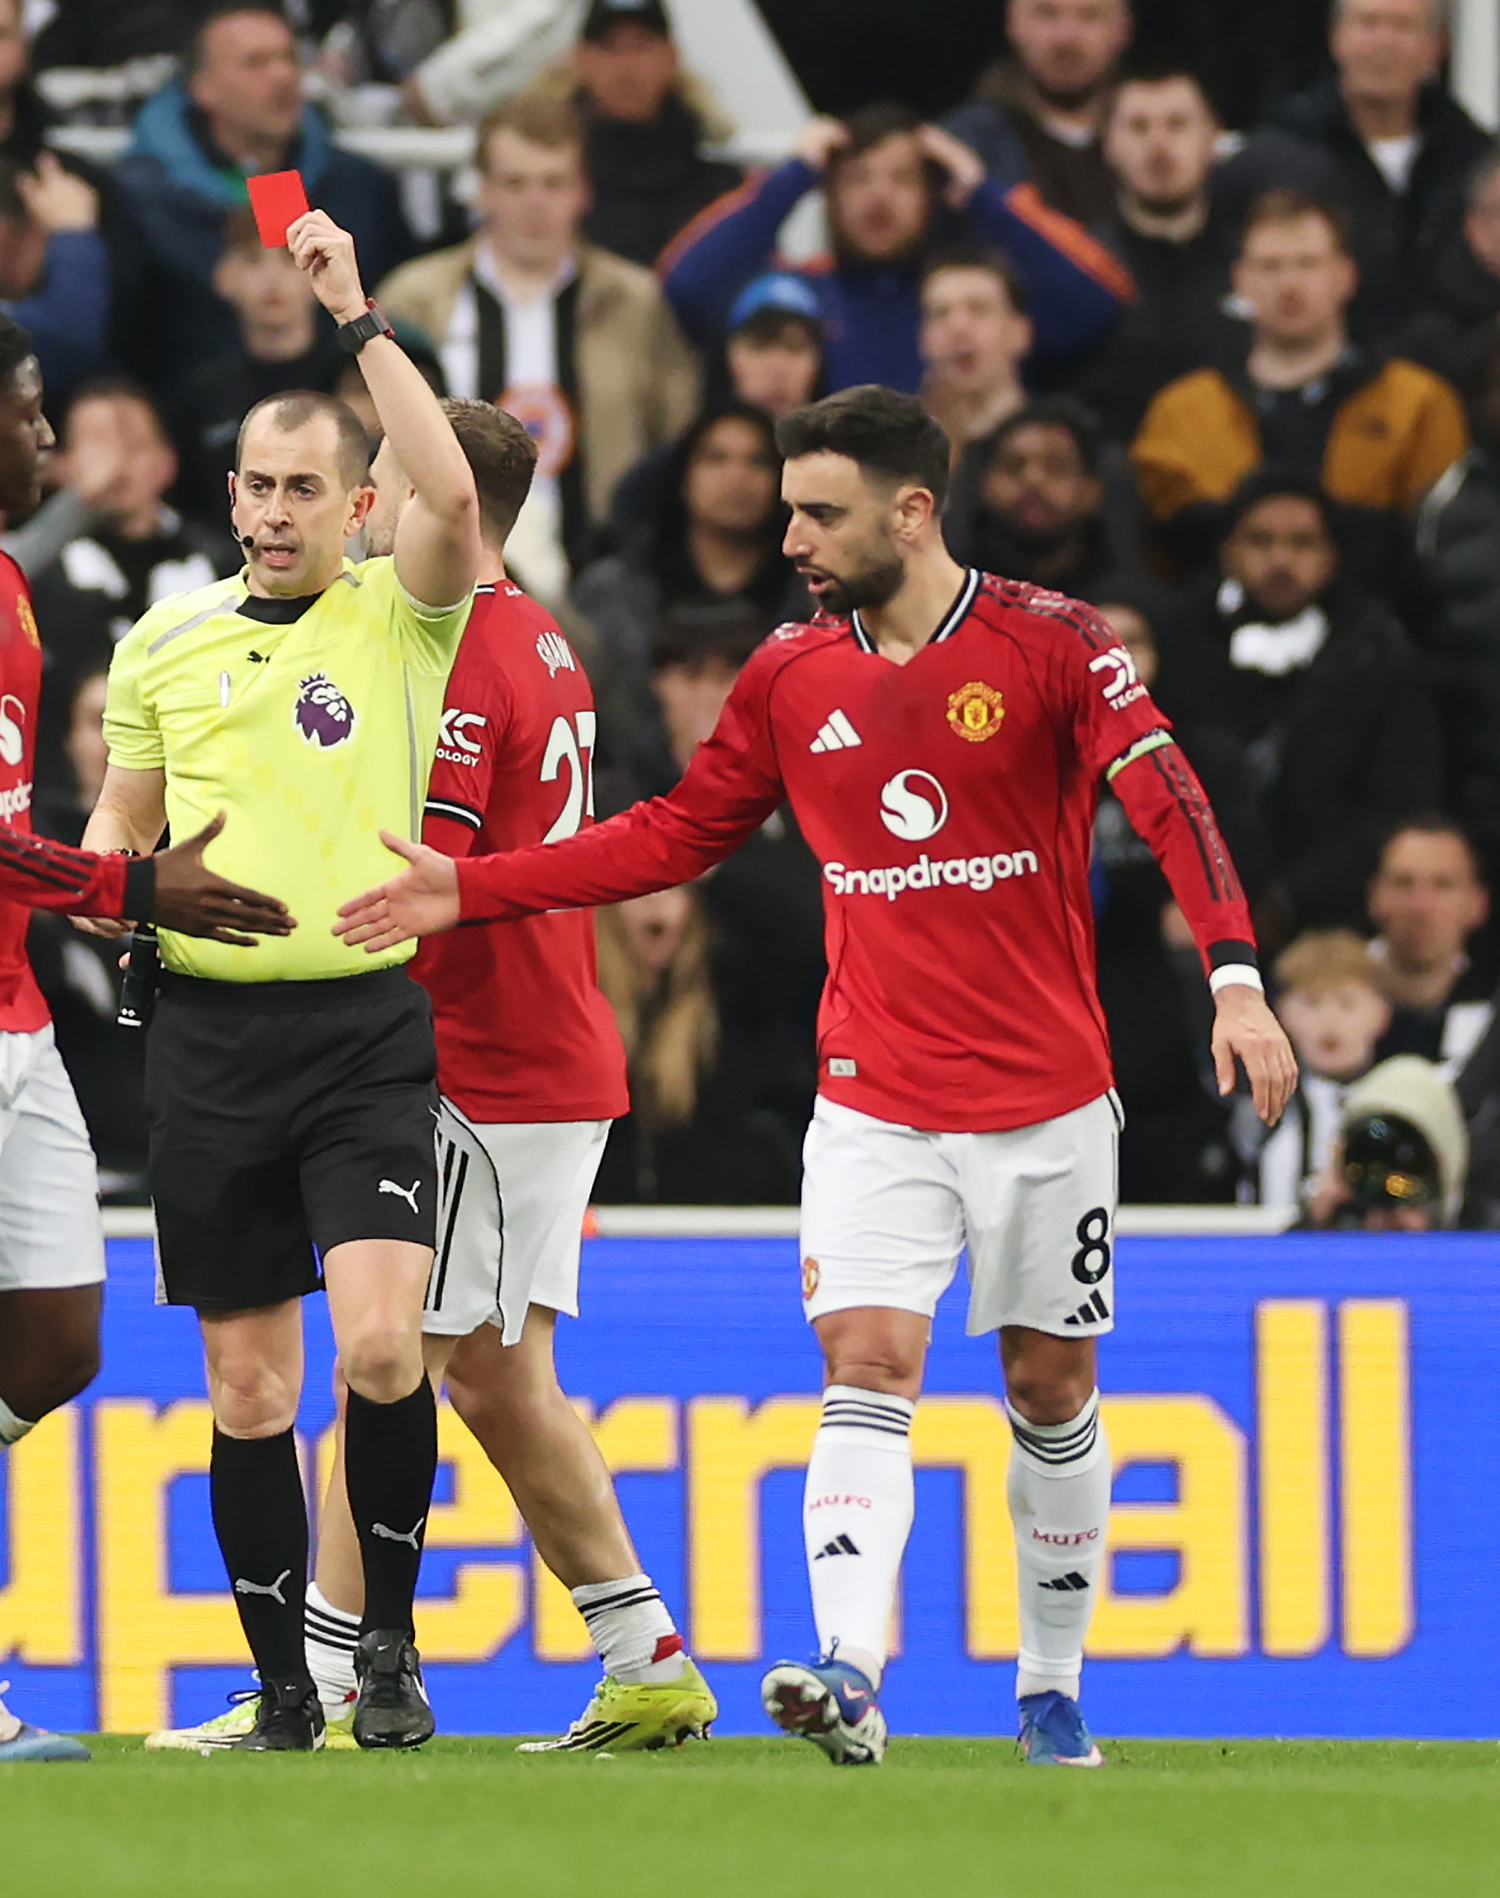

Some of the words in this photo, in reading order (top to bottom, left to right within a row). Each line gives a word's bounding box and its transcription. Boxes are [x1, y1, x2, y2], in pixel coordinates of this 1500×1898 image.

[435, 748, 480, 767] OLOGY
[540, 711, 597, 846] 27
[823, 854, 1038, 901] Snapdragon
[1071, 1206, 1111, 1285] 8
